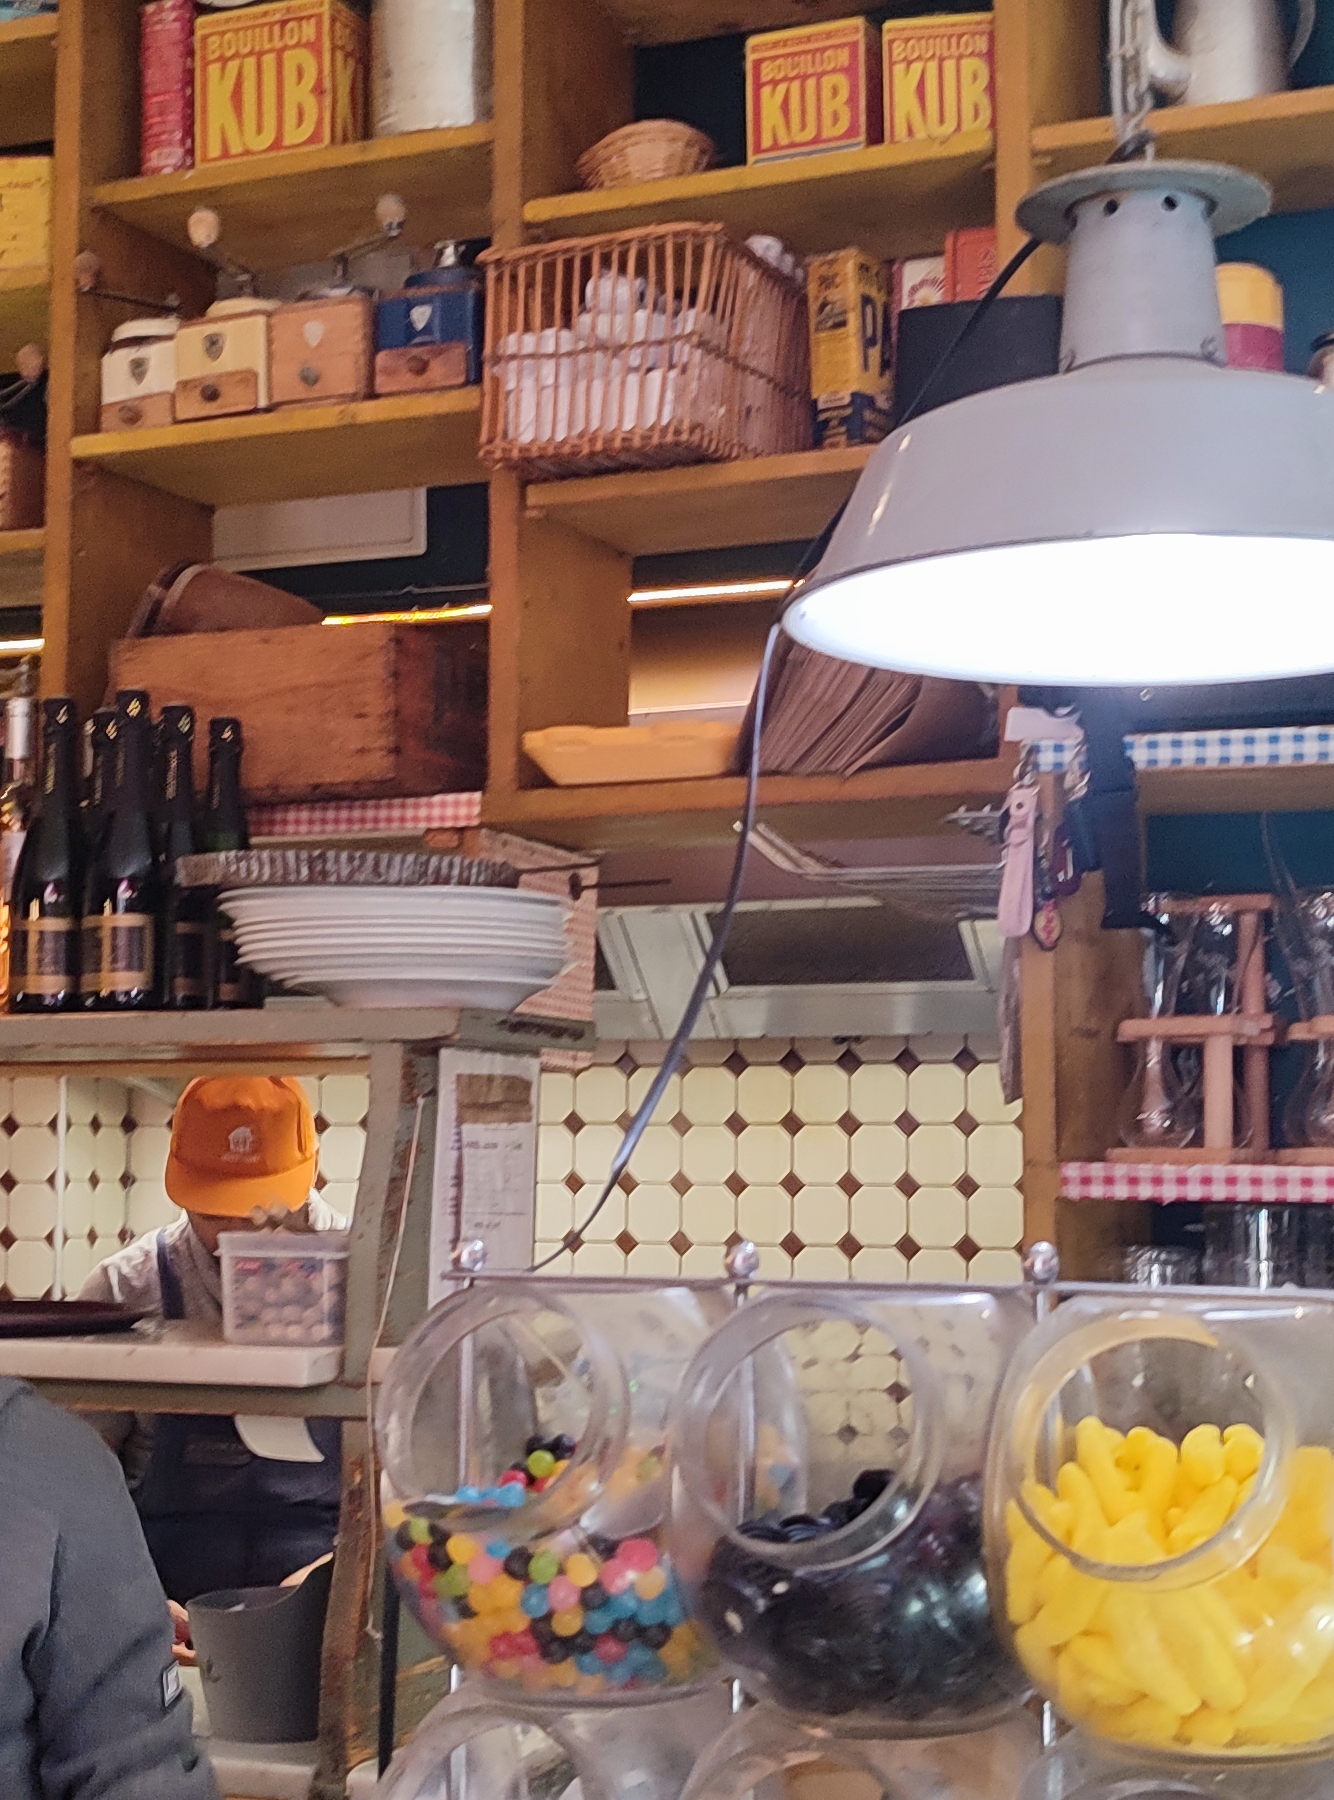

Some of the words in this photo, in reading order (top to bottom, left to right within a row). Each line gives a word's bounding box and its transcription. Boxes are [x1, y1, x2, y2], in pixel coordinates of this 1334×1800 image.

[206, 17, 317, 61] BOUILLON
[761, 47, 850, 81] BOUILLON
[892, 34, 989, 63] BOUILLON
[205, 48, 319, 159] KUB
[759, 73, 851, 149] KUB
[890, 58, 993, 144] KUB
